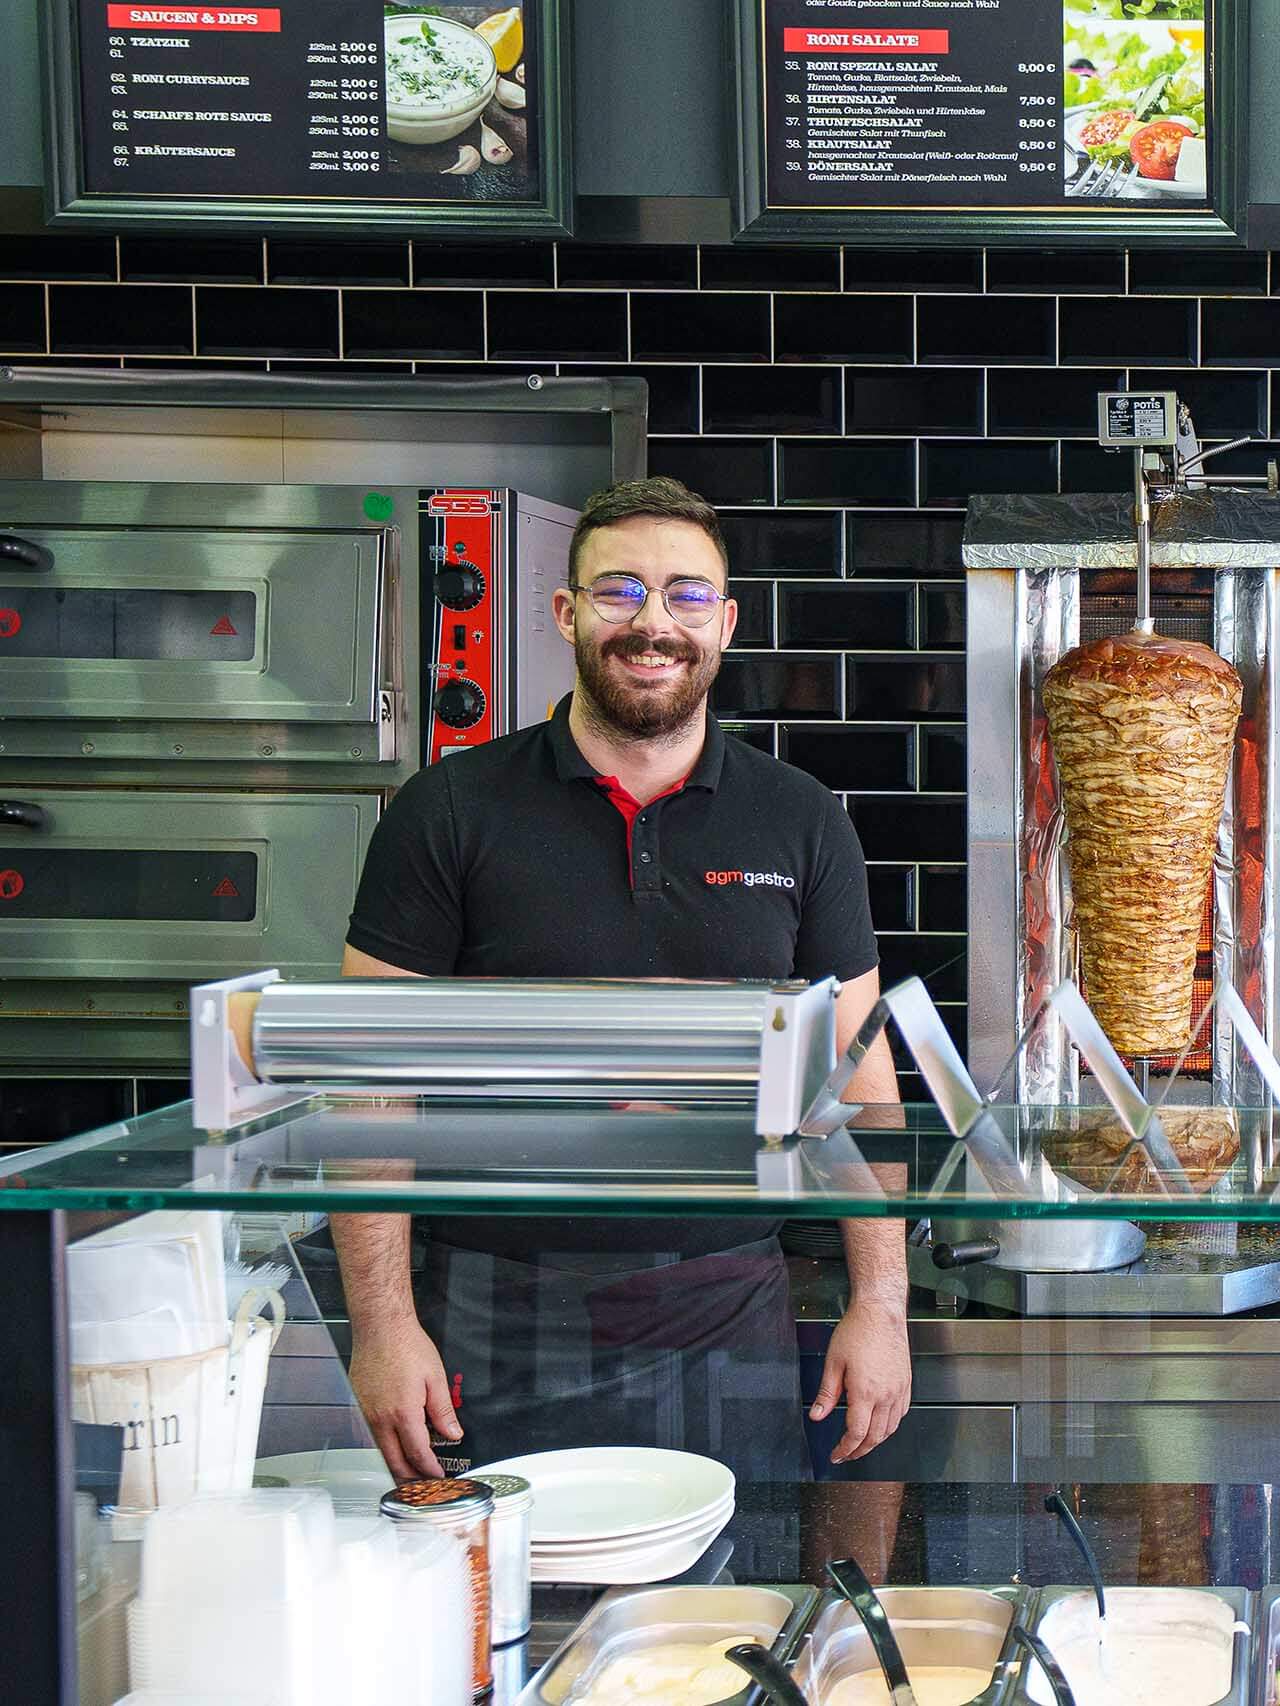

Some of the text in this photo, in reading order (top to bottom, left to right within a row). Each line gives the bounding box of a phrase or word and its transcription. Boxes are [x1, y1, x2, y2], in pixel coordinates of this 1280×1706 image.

[130, 10, 258, 25] SAUCEN & DIPS
[109, 37, 126, 46] 60.
[130, 37, 190, 48] TZATZIKI
[340, 42, 366, 52] 2,00
[368, 43, 377, 52] €
[806, 34, 919, 47] RONI SALATE
[340, 55, 366, 64] 3,00
[368, 55, 377, 64] €
[807, 61, 839, 71] RONI
[840, 62, 894, 72] SPEZIAL
[896, 63, 938, 72] SALAT
[1018, 64, 1045, 73] 8,00
[1047, 64, 1056, 73] €
[132, 74, 165, 84] RONI
[166, 75, 250, 86] CURRYSAUCE
[341, 79, 367, 88] 2,00
[368, 80, 378, 88] €
[984, 85, 1008, 93] Mais
[341, 91, 368, 101] 3,00
[369, 92, 378, 100] €
[807, 95, 897, 104] HIRTENSALAT
[1020, 97, 1045, 106] 7,50
[1047, 97, 1056, 105] €
[874, 107, 915, 115] Zwiebeln
[133, 110, 194, 120] SCHARFE
[195, 112, 229, 121] ROTE
[230, 113, 272, 122] SAUCE
[342, 115, 368, 124] 2,00
[370, 116, 379, 124] €
[786, 117, 1056, 128] 37. THUNFISCHSALAT 8,50 €
[342, 127, 368, 136] 3,00
[370, 128, 379, 136] €
[808, 129, 859, 137] Gemischter
[860, 129, 883, 137] Salat
[901, 130, 946, 139] Thunfisch
[808, 140, 892, 149] KRAUTSALAT
[1019, 141, 1045, 151] 6,50
[1047, 141, 1056, 150] €
[134, 145, 236, 157] KRÄUTERSAUCE
[343, 151, 369, 160] 2,00
[370, 151, 380, 160] €
[878, 152, 924, 160] Krautsalat
[343, 162, 369, 172] 3,00
[370, 163, 380, 171] €
[808, 161, 894, 171] DÖNERSALAT
[1020, 163, 1045, 172] 9,50
[1047, 163, 1056, 172] €
[808, 173, 859, 181] Gemischter
[705, 870, 795, 888] ggmgastro
